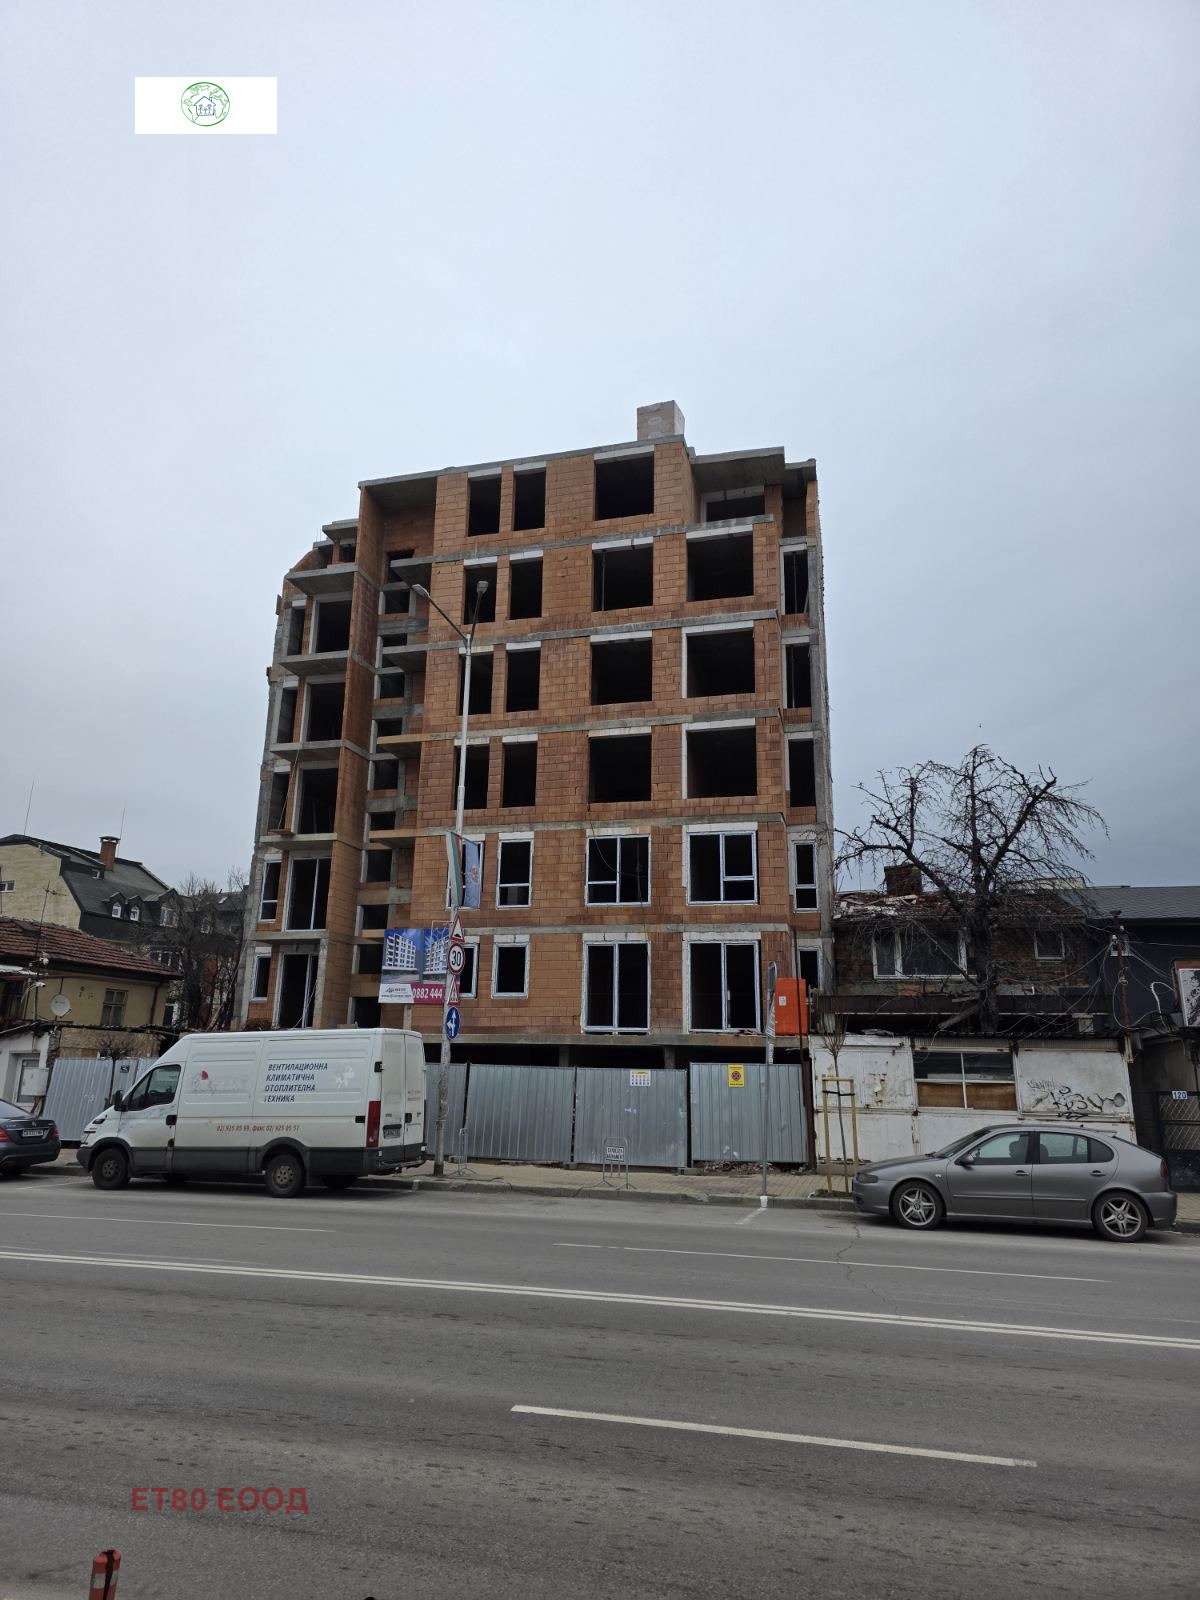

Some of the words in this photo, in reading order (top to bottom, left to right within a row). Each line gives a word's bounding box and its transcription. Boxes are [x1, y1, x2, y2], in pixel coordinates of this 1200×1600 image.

[452, 950, 461, 966] 30
[412, 988, 429, 999] 0882
[430, 988, 443, 999] 444
[268, 1063, 328, 1071] ВЕНТИЛАЦИОННА
[265, 1084, 315, 1092] ОТОПЛИТЕЛНА
[1174, 1091, 1187, 1099] 120
